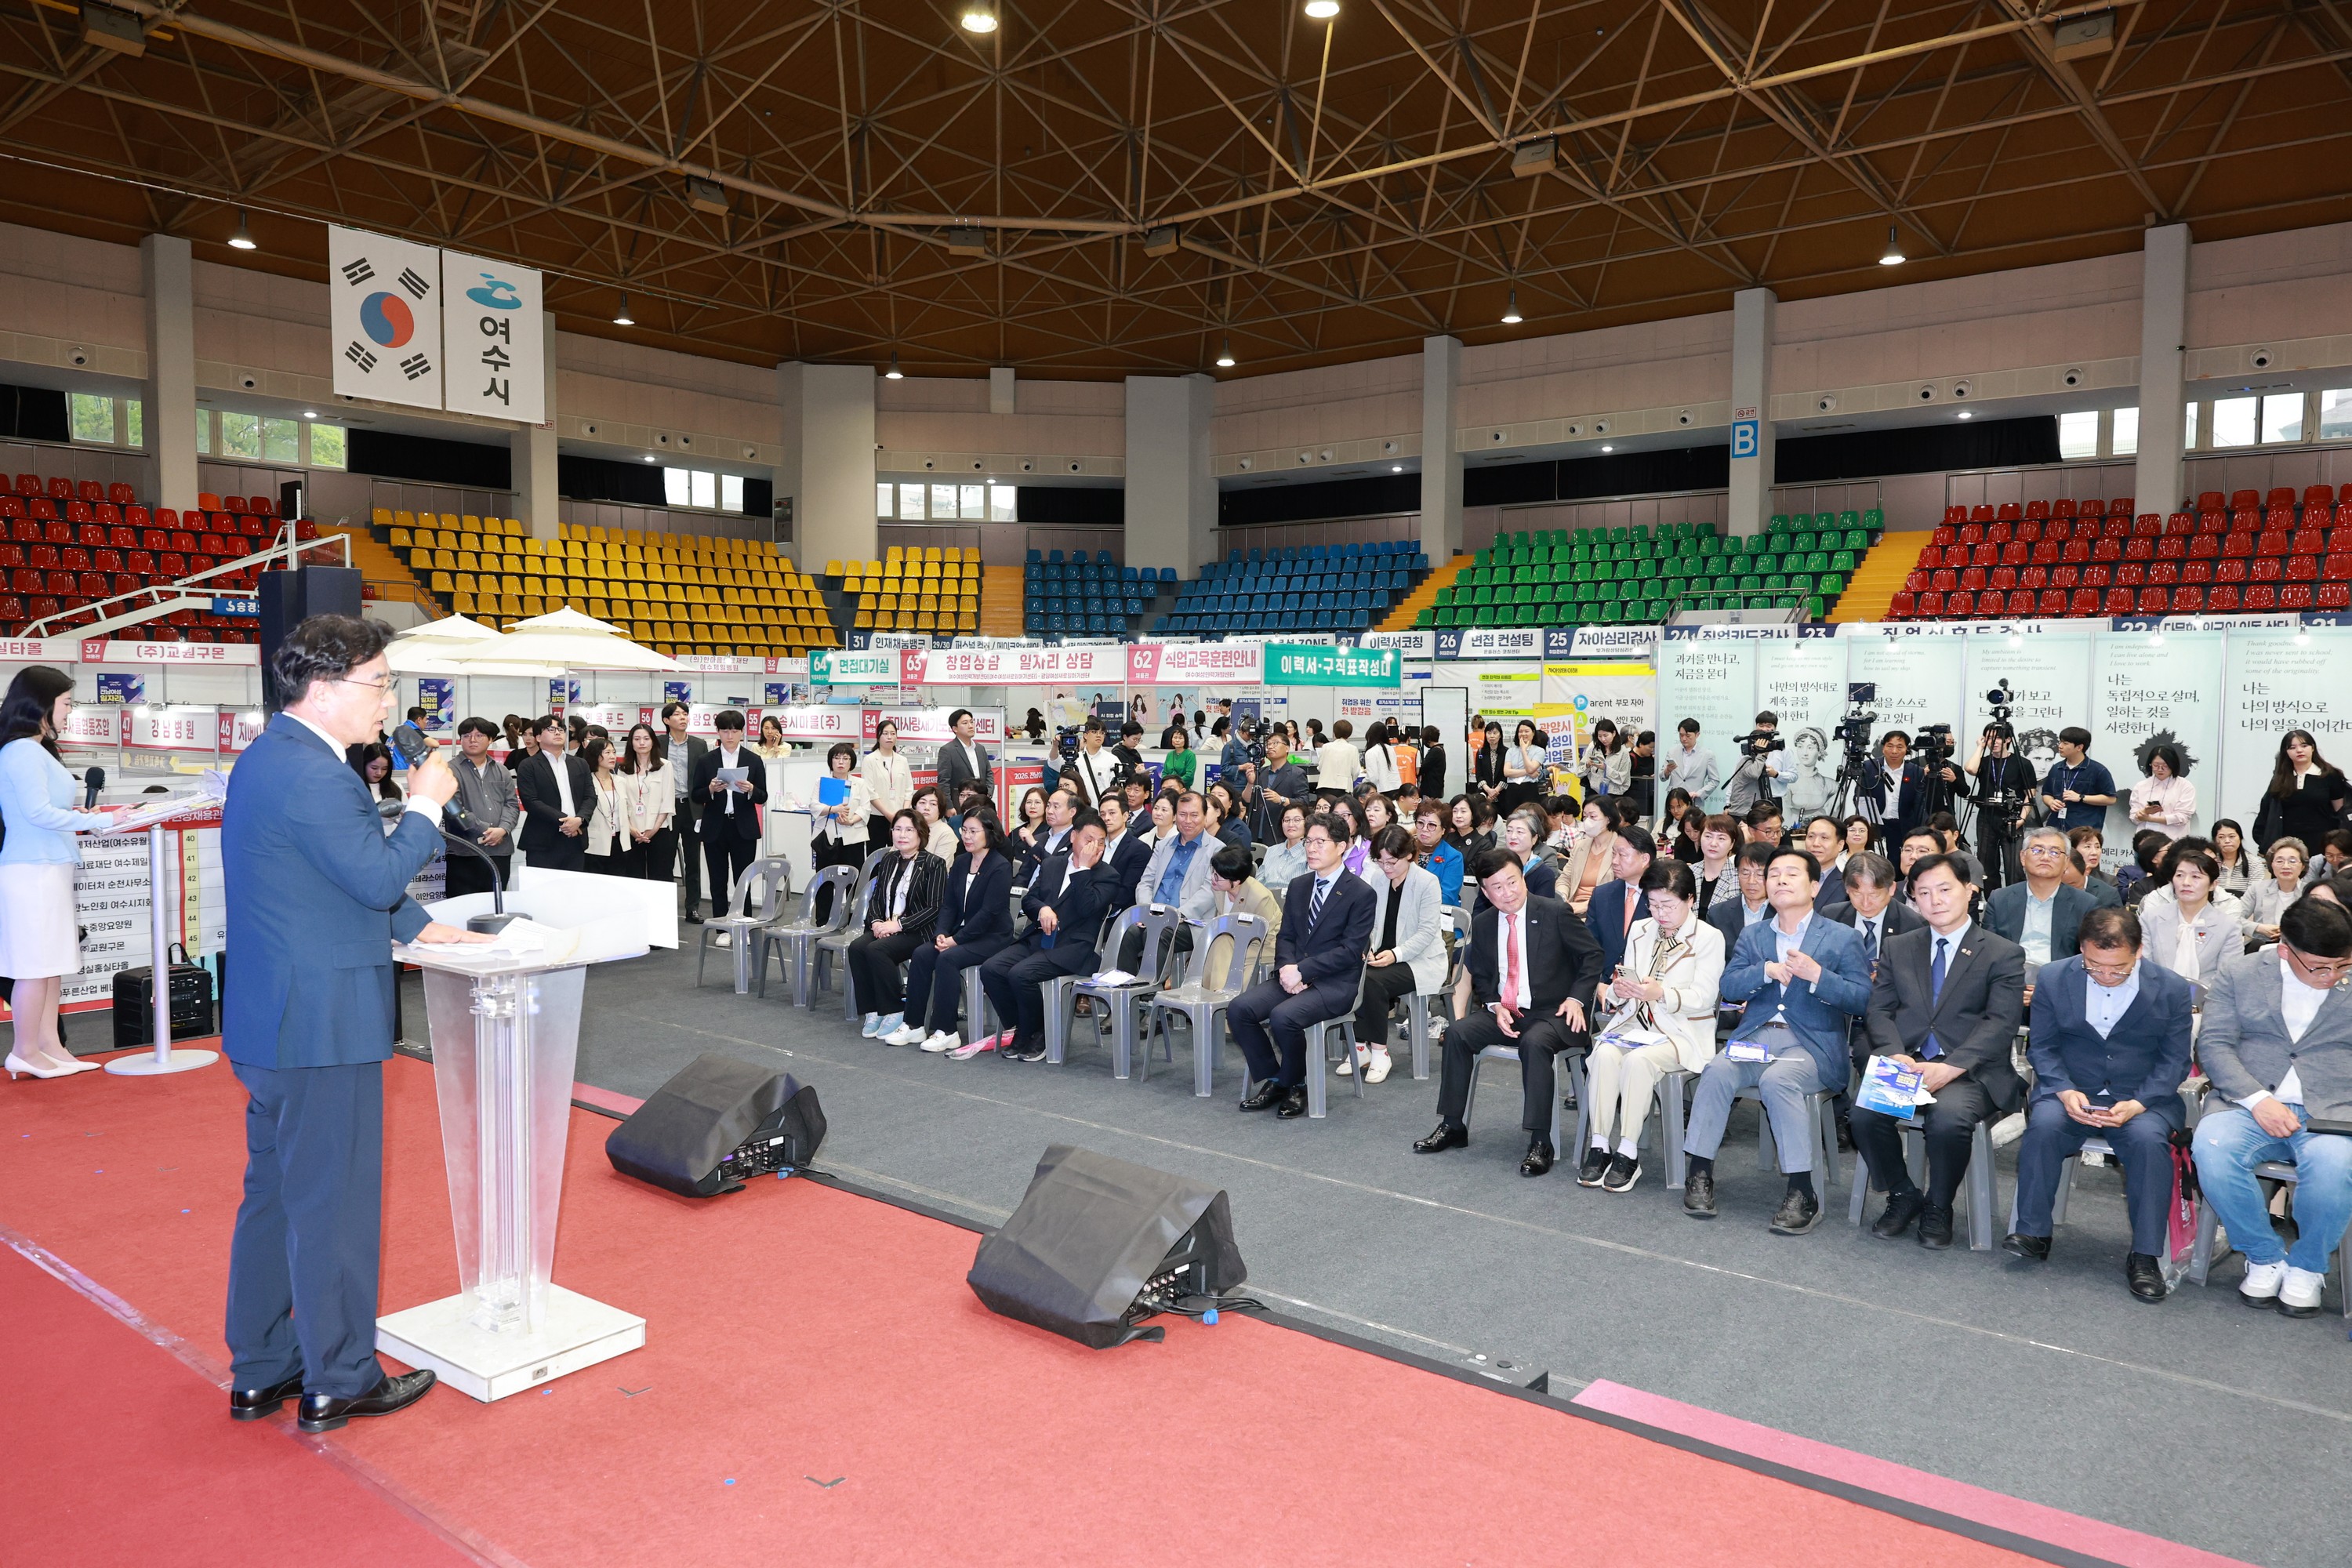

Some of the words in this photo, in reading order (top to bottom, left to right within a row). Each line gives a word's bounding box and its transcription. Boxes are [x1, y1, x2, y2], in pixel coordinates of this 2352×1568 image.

[479, 316, 510, 406] 여수시
[1734, 424, 1755, 455] B
[853, 635, 864, 648] 31
[1370, 636, 1424, 649] 이력서코칭
[1439, 635, 1457, 648] 26
[1472, 634, 1494, 648] 면접
[1498, 633, 1534, 646] 컨설팅
[1549, 633, 1567, 646] 25
[1579, 631, 1657, 646] 자아심리검사
[85, 644, 100, 653] 37
[136, 644, 224, 659] (주)교원구몬
[814, 656, 826, 671] 64
[906, 655, 921, 671] 63
[946, 655, 1000, 671] 창업상담
[1020, 653, 1059, 670] 일자리
[1066, 652, 1093, 670] 상담
[1133, 651, 1152, 669] 62
[1165, 649, 1257, 668] 직업교육훈련안내
[1675, 654, 1706, 665] 과거를
[1708, 653, 1740, 665] 만나고,
[839, 658, 889, 673] 면접대기실
[1281, 655, 1391, 677] 이력서·구직표작성대
[1675, 668, 1705, 680] 지금을
[1708, 668, 1727, 680] 묻다
[2108, 673, 2132, 686] 나는
[1770, 681, 1798, 691] 나만의
[1800, 681, 1838, 692] 방식대로
[2243, 682, 2270, 695] 나는
[1769, 696, 1788, 706] 계속
[1791, 696, 1809, 706] 글을
[2028, 691, 2051, 701] 보고
[2107, 690, 2169, 702] 독립적으로
[2172, 690, 2200, 702] 살며,
[1631, 699, 1644, 707] 자아
[1896, 698, 1928, 708] 스스로
[2242, 699, 2269, 713] 나의
[2272, 700, 2328, 713] 방식으로
[641, 713, 651, 722] 56
[1790, 710, 1809, 721] 한다
[1894, 713, 1915, 724] 있다
[2028, 706, 2063, 718] 그린다
[2107, 706, 2143, 718] 일하는
[2147, 706, 2171, 718] 것을
[122, 717, 129, 731] 47
[749, 714, 757, 724] 55
[865, 715, 877, 726] 54
[2241, 718, 2267, 731] 나의
[151, 719, 194, 740] 강남병원
[220, 720, 230, 735] 46
[1540, 720, 1571, 734] 광양시
[2106, 721, 2155, 734] 사랑한다
[2101, 848, 2118, 857] 메리
